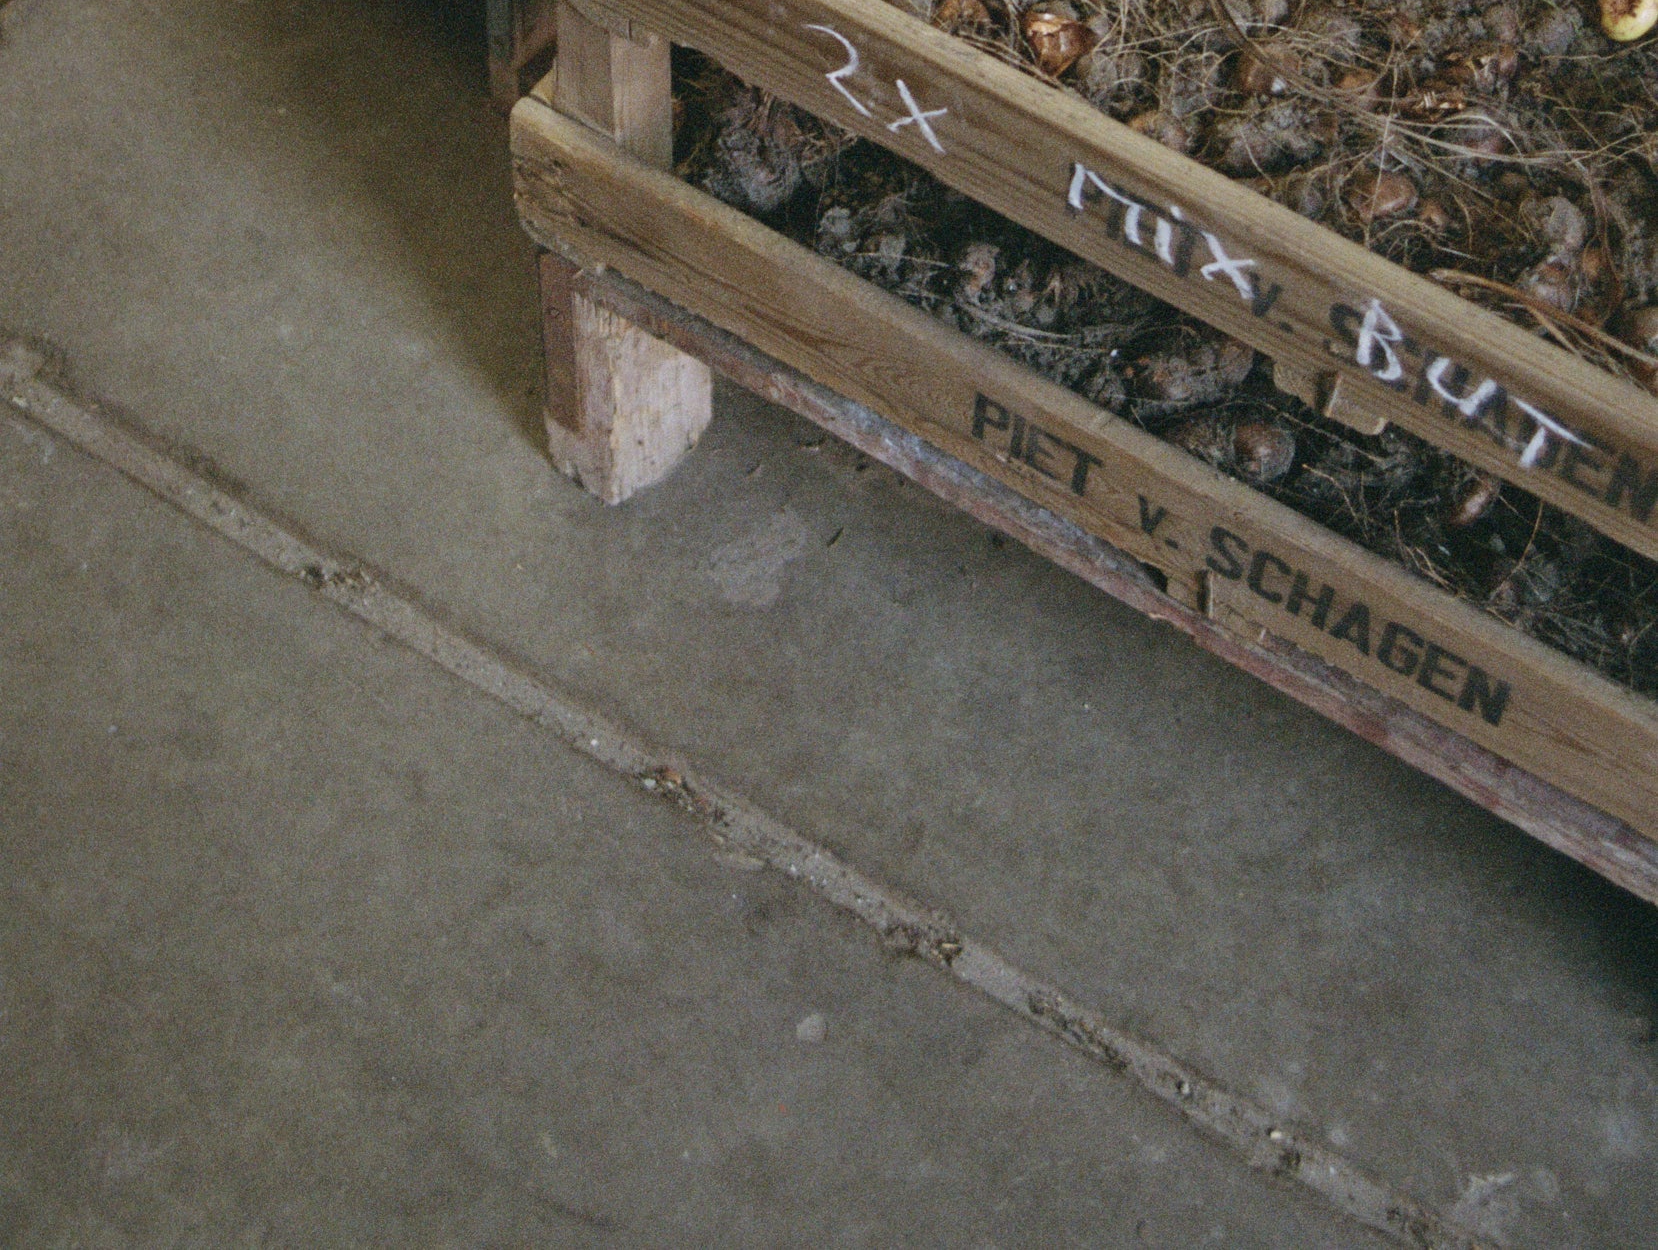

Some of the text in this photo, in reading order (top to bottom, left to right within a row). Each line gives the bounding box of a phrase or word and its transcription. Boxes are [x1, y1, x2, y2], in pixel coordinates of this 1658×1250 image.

[1357, 298, 1594, 468] BUT
[970, 391, 1105, 498] PIET
[1206, 526, 1513, 727] SCHAGEN
